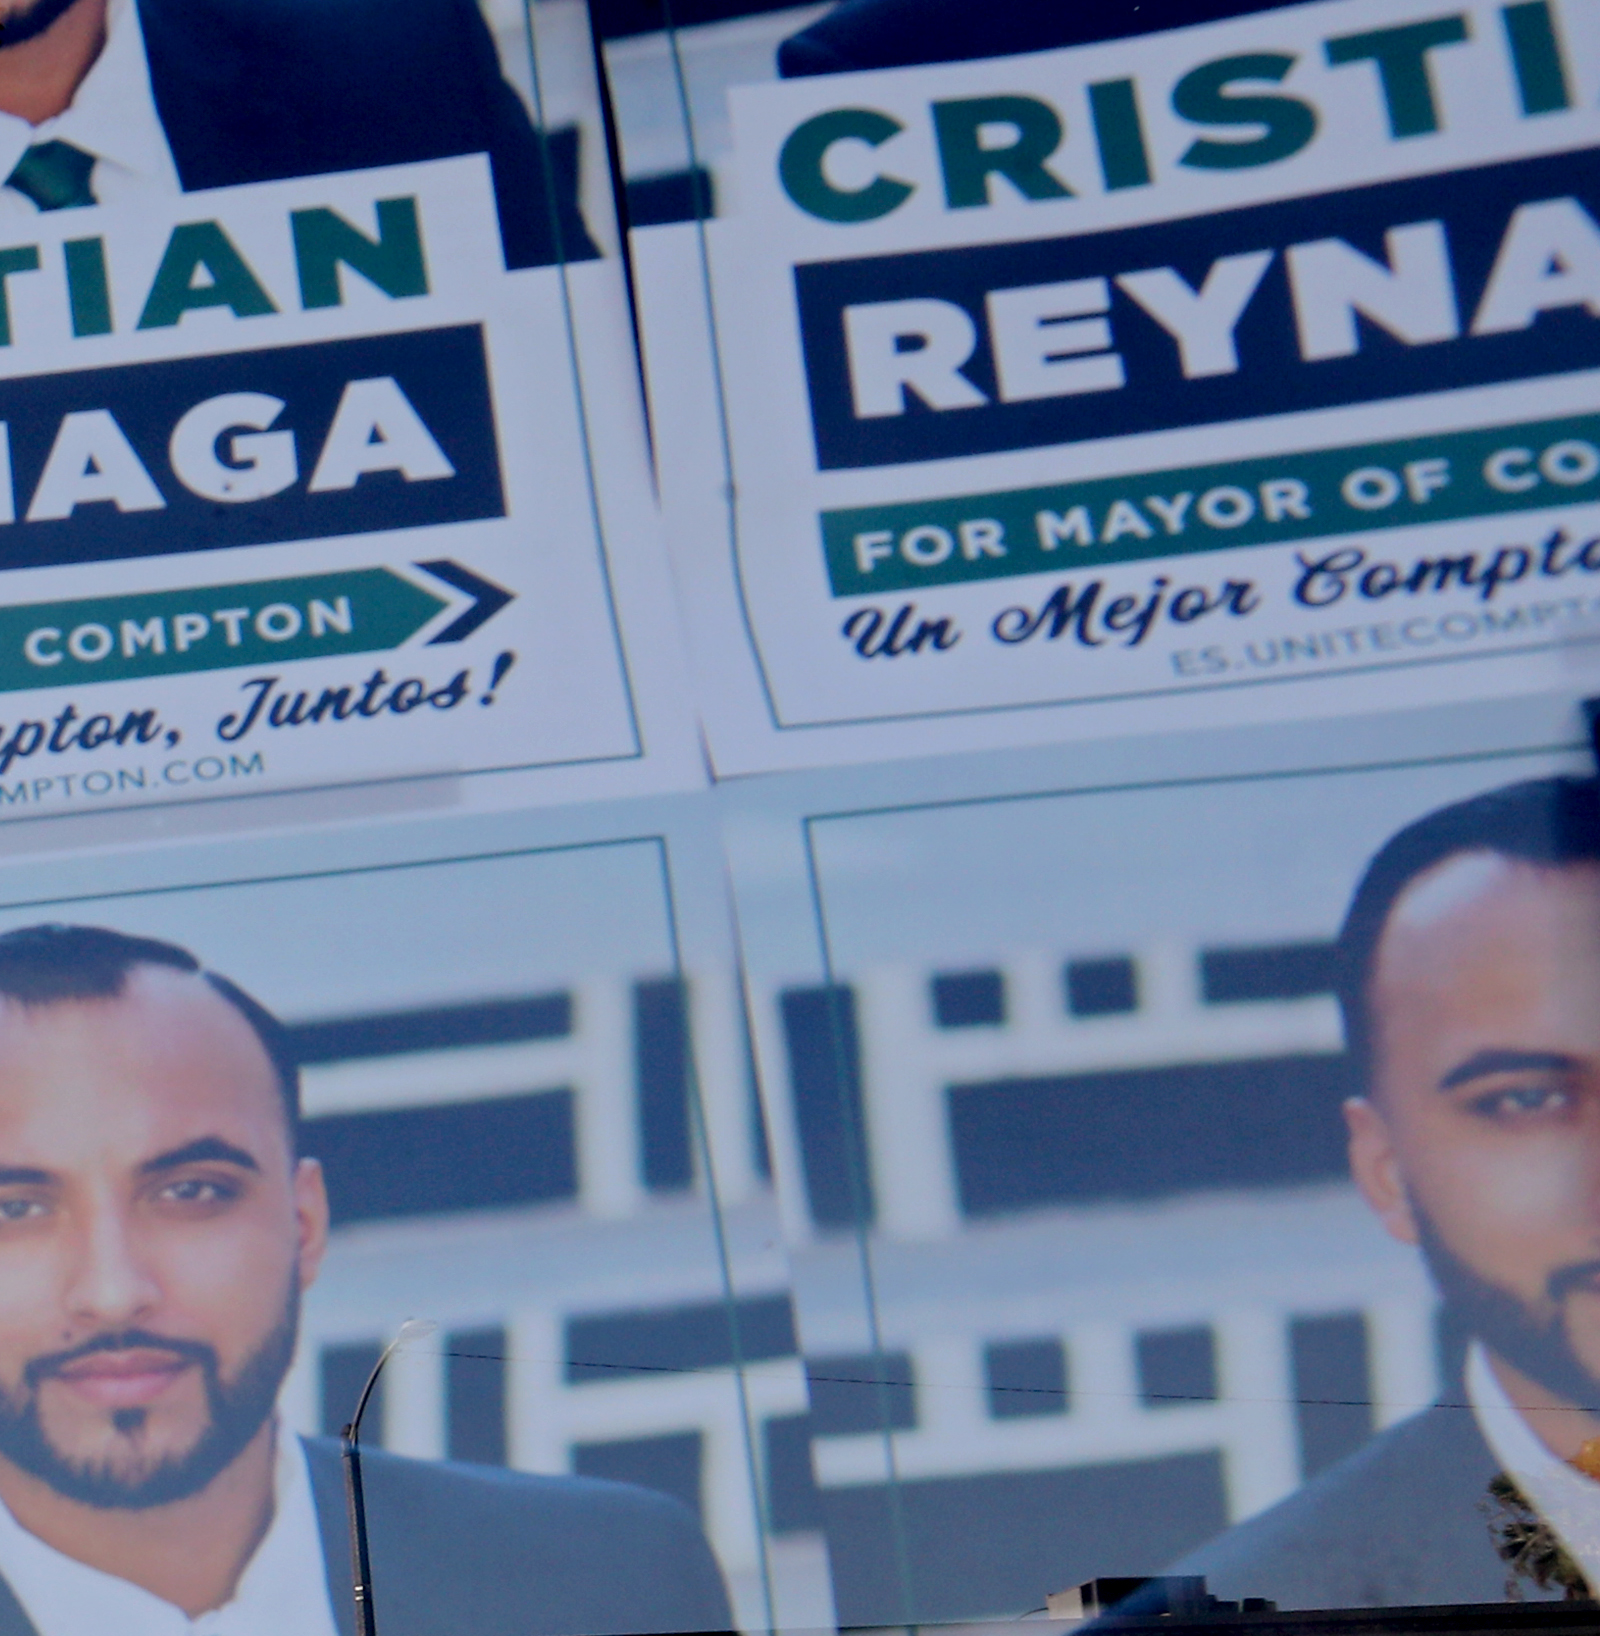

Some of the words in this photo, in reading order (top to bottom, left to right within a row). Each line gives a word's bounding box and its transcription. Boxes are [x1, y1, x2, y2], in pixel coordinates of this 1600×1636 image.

[779, 0, 1575, 225] CRISTI
[843, 197, 1600, 420] REYNA
[853, 518, 1008, 574] FOR
[1035, 478, 1311, 551] MAYOR
[1341, 458, 1452, 512] OF
[23, 596, 355, 666] COMPTON
[842, 601, 960, 660] Un
[991, 577, 1262, 648] Mejor
[217, 650, 518, 740] Juntos!
